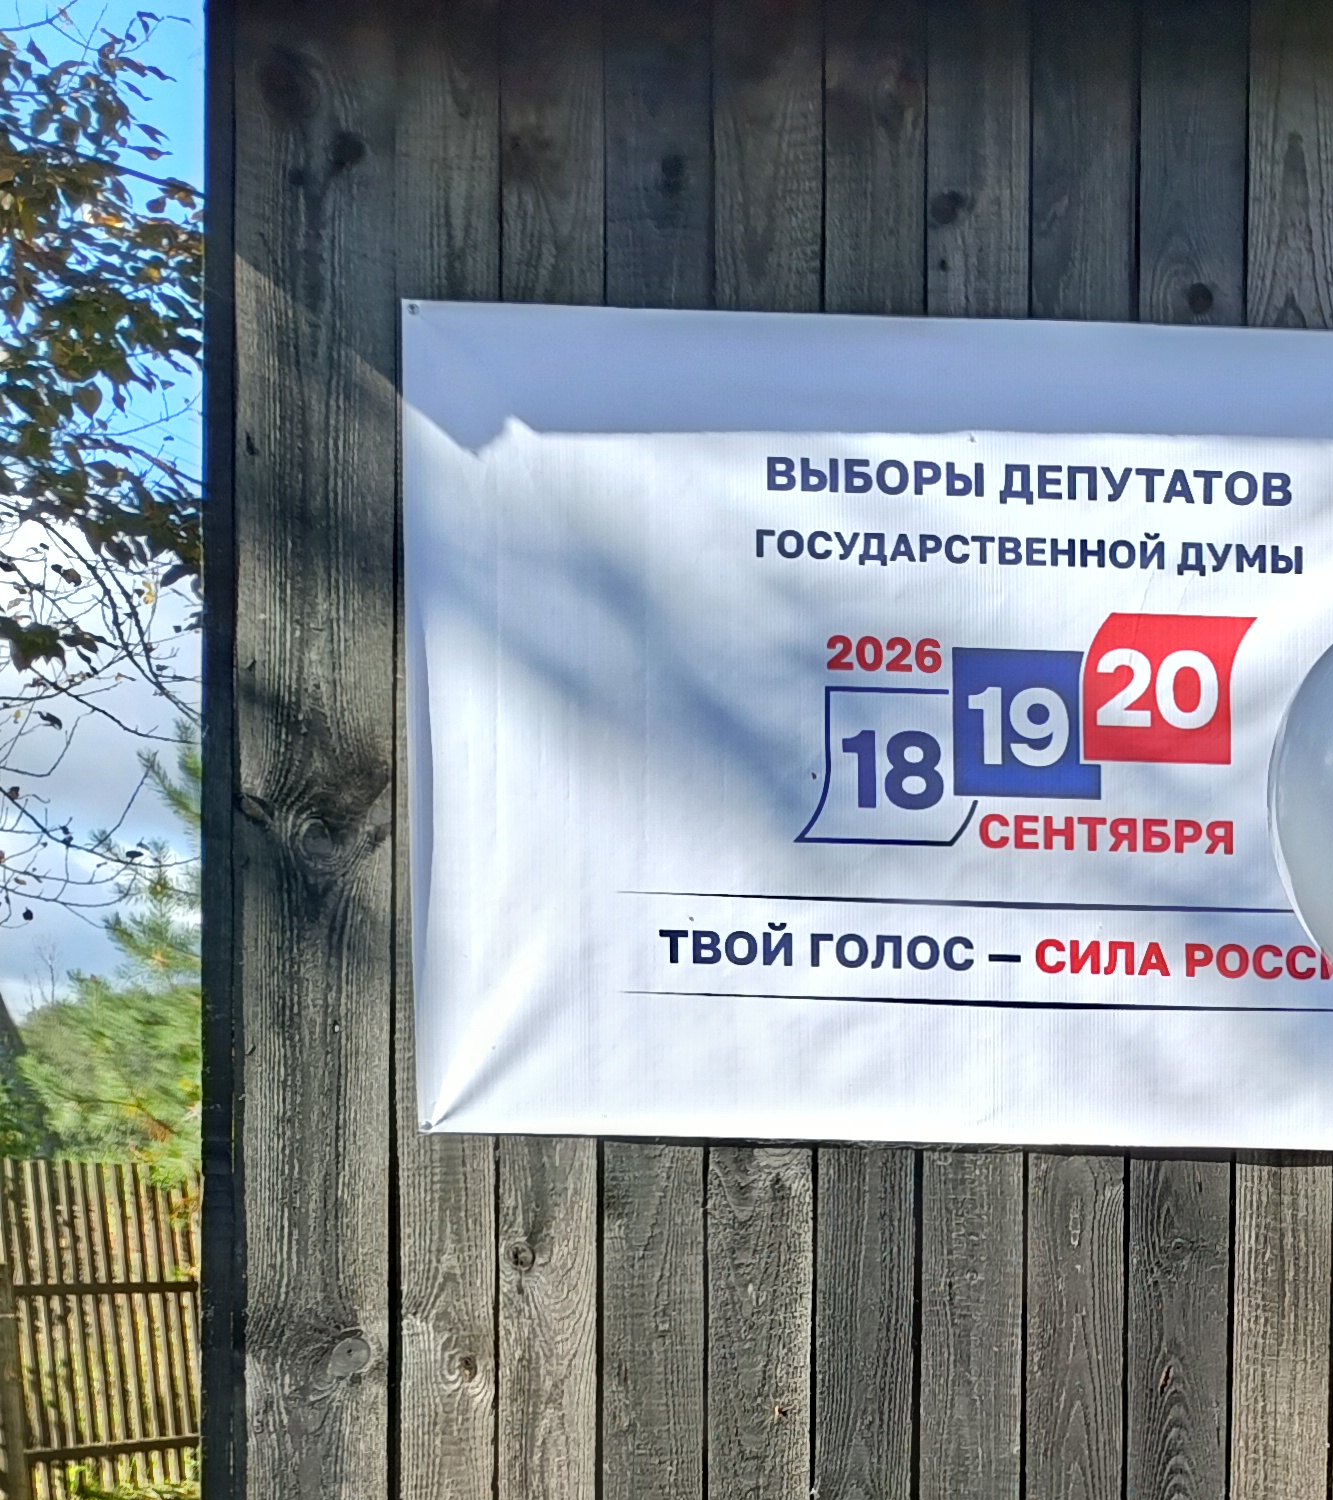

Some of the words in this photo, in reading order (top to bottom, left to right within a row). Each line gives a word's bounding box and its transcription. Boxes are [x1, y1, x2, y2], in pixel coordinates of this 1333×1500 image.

[765, 455, 986, 500] ВЫБОРЫ
[999, 460, 1294, 508] ДЕПУТАТОВ
[754, 529, 1167, 573] ГОСУДАРСТВЕННОЙ
[1176, 540, 1304, 578] ДУМЫ
[825, 636, 943, 675] 2026
[840, 730, 945, 812] 18
[967, 684, 1070, 768] 19
[1095, 648, 1220, 731] 20
[978, 812, 1235, 855] СЕНТЯБРЯ
[659, 921, 795, 969] ТВОЙ
[809, 931, 975, 973] ГОЛОС
[1034, 937, 1171, 979] СИЛА
